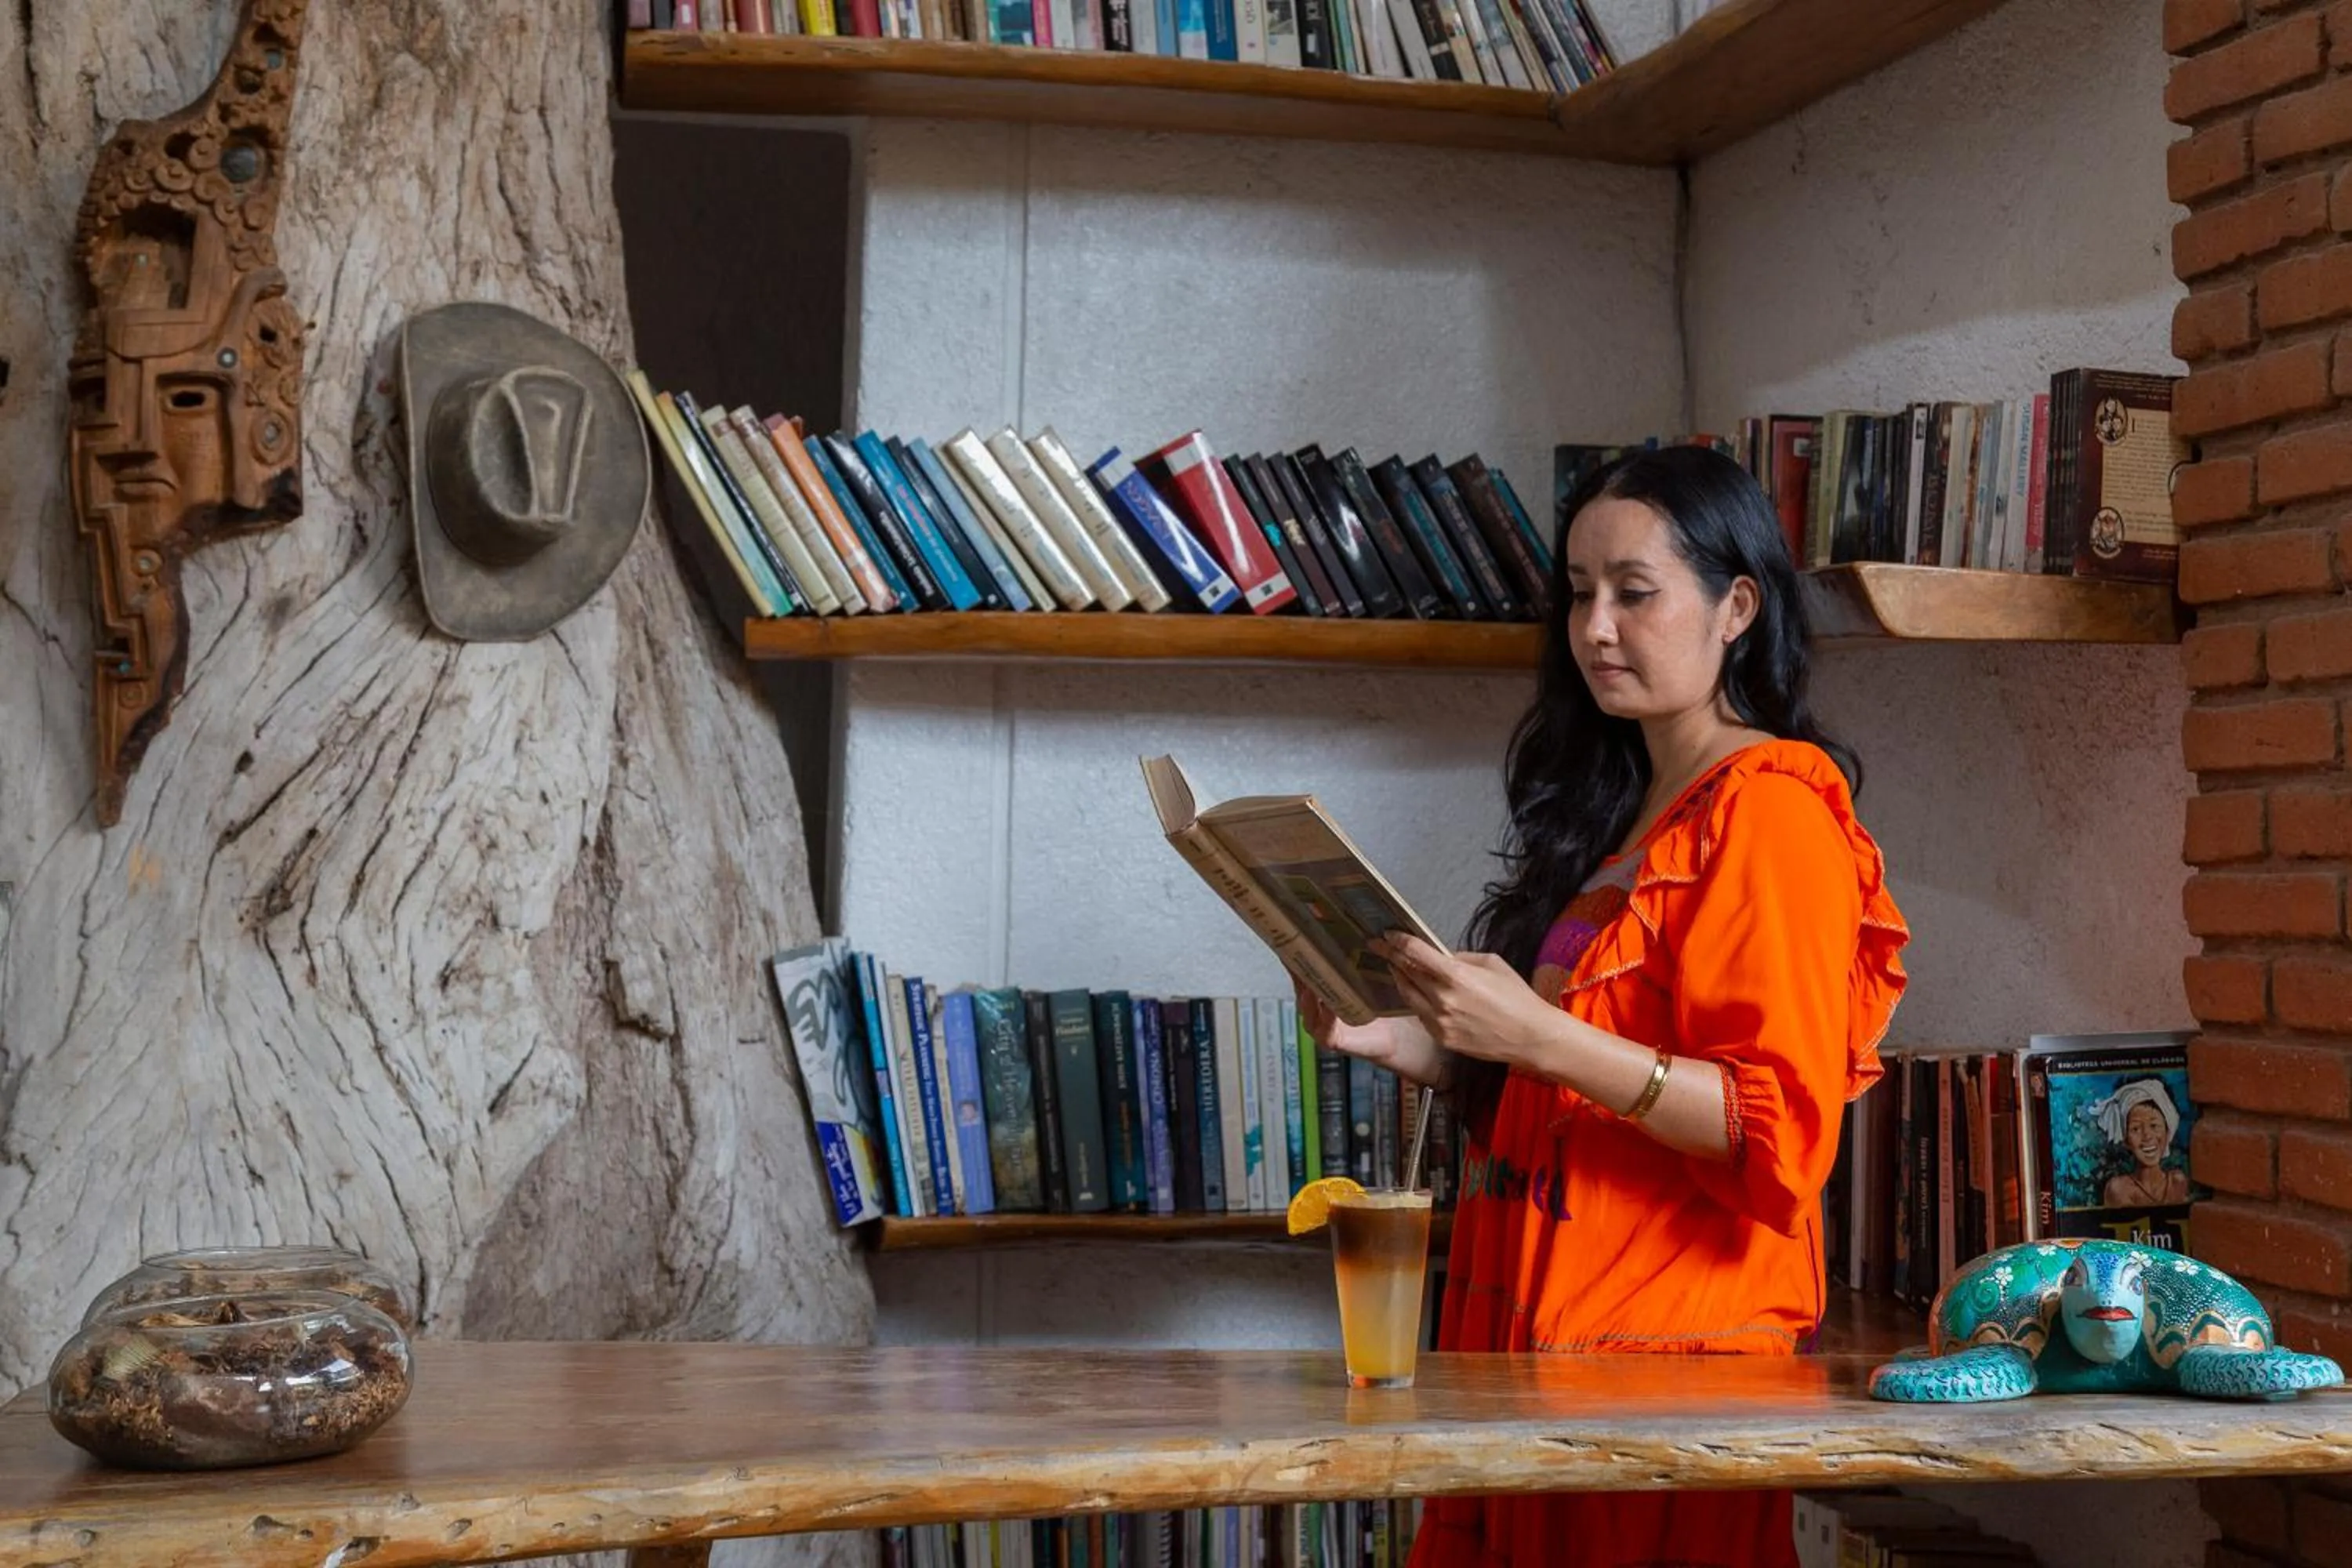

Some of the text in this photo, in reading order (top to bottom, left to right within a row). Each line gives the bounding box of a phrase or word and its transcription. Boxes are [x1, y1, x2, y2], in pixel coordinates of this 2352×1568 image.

[993, 1018, 1016, 1051] City
[1198, 1039, 1216, 1112] HEREDERA
[2057, 1061, 2098, 1069] BIBLIOTECA
[2041, 1191, 2052, 1225] Kim
[2132, 1229, 2172, 1250] Kim
